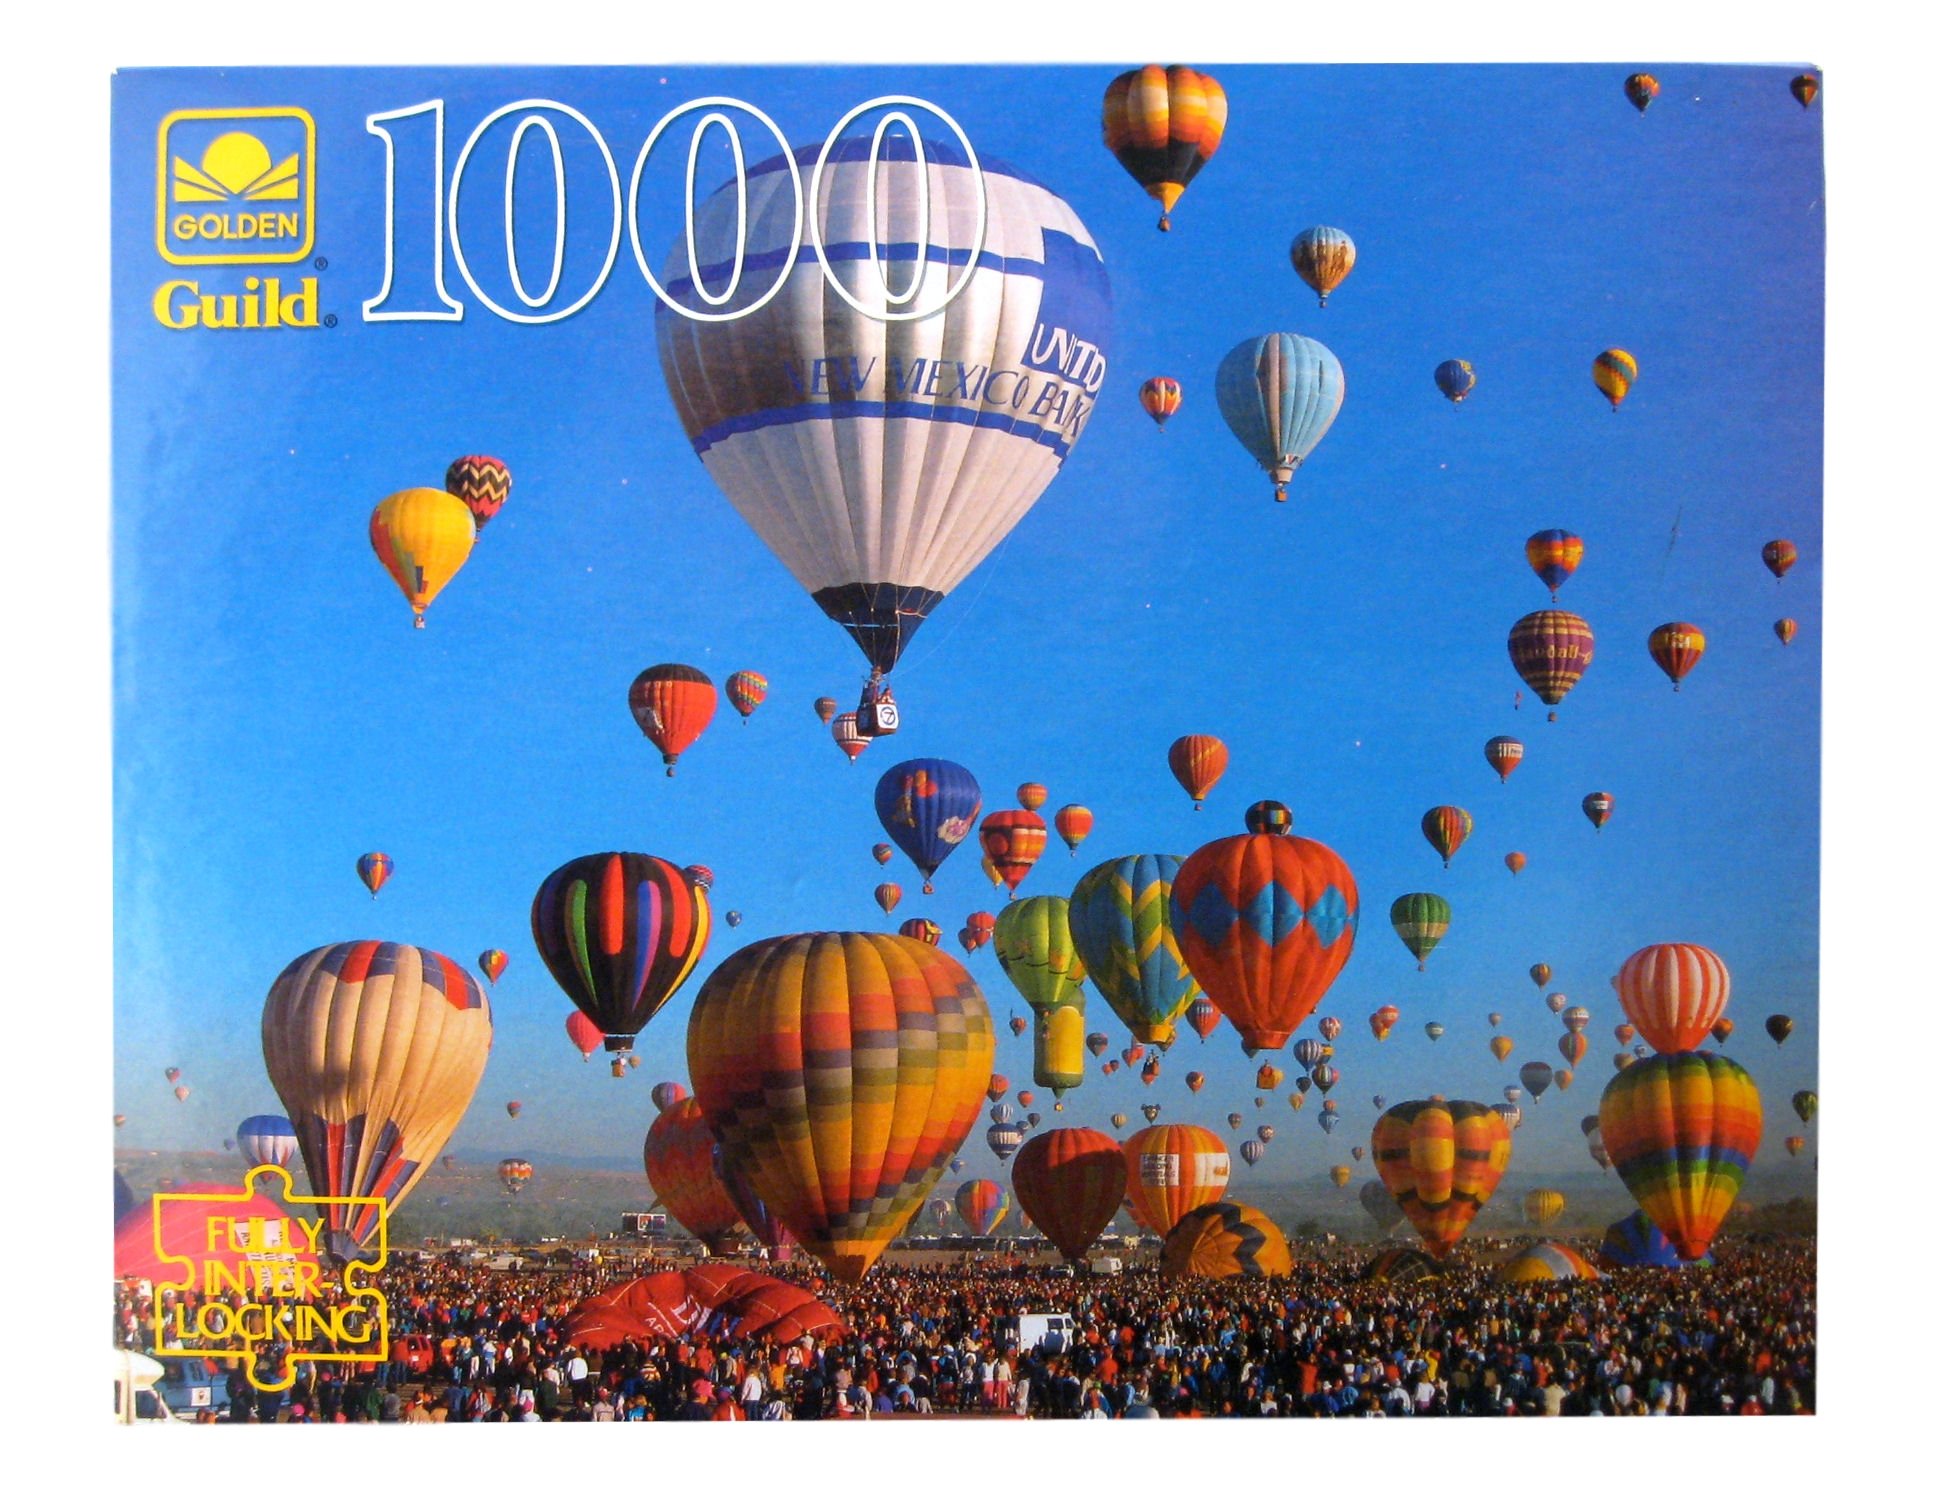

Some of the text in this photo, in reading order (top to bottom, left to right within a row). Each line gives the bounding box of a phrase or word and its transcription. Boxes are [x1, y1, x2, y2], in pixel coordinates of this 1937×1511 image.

[173, 212, 299, 240] GOLDEN
[362, 95, 987, 325] 1000
[153, 276, 320, 330] Guild
[782, 355, 1091, 437] NEW MEXICO BANK
[206, 1216, 326, 1254] FULLY
[203, 1260, 336, 1298] INTER-
[175, 1302, 371, 1343] LOCKING
